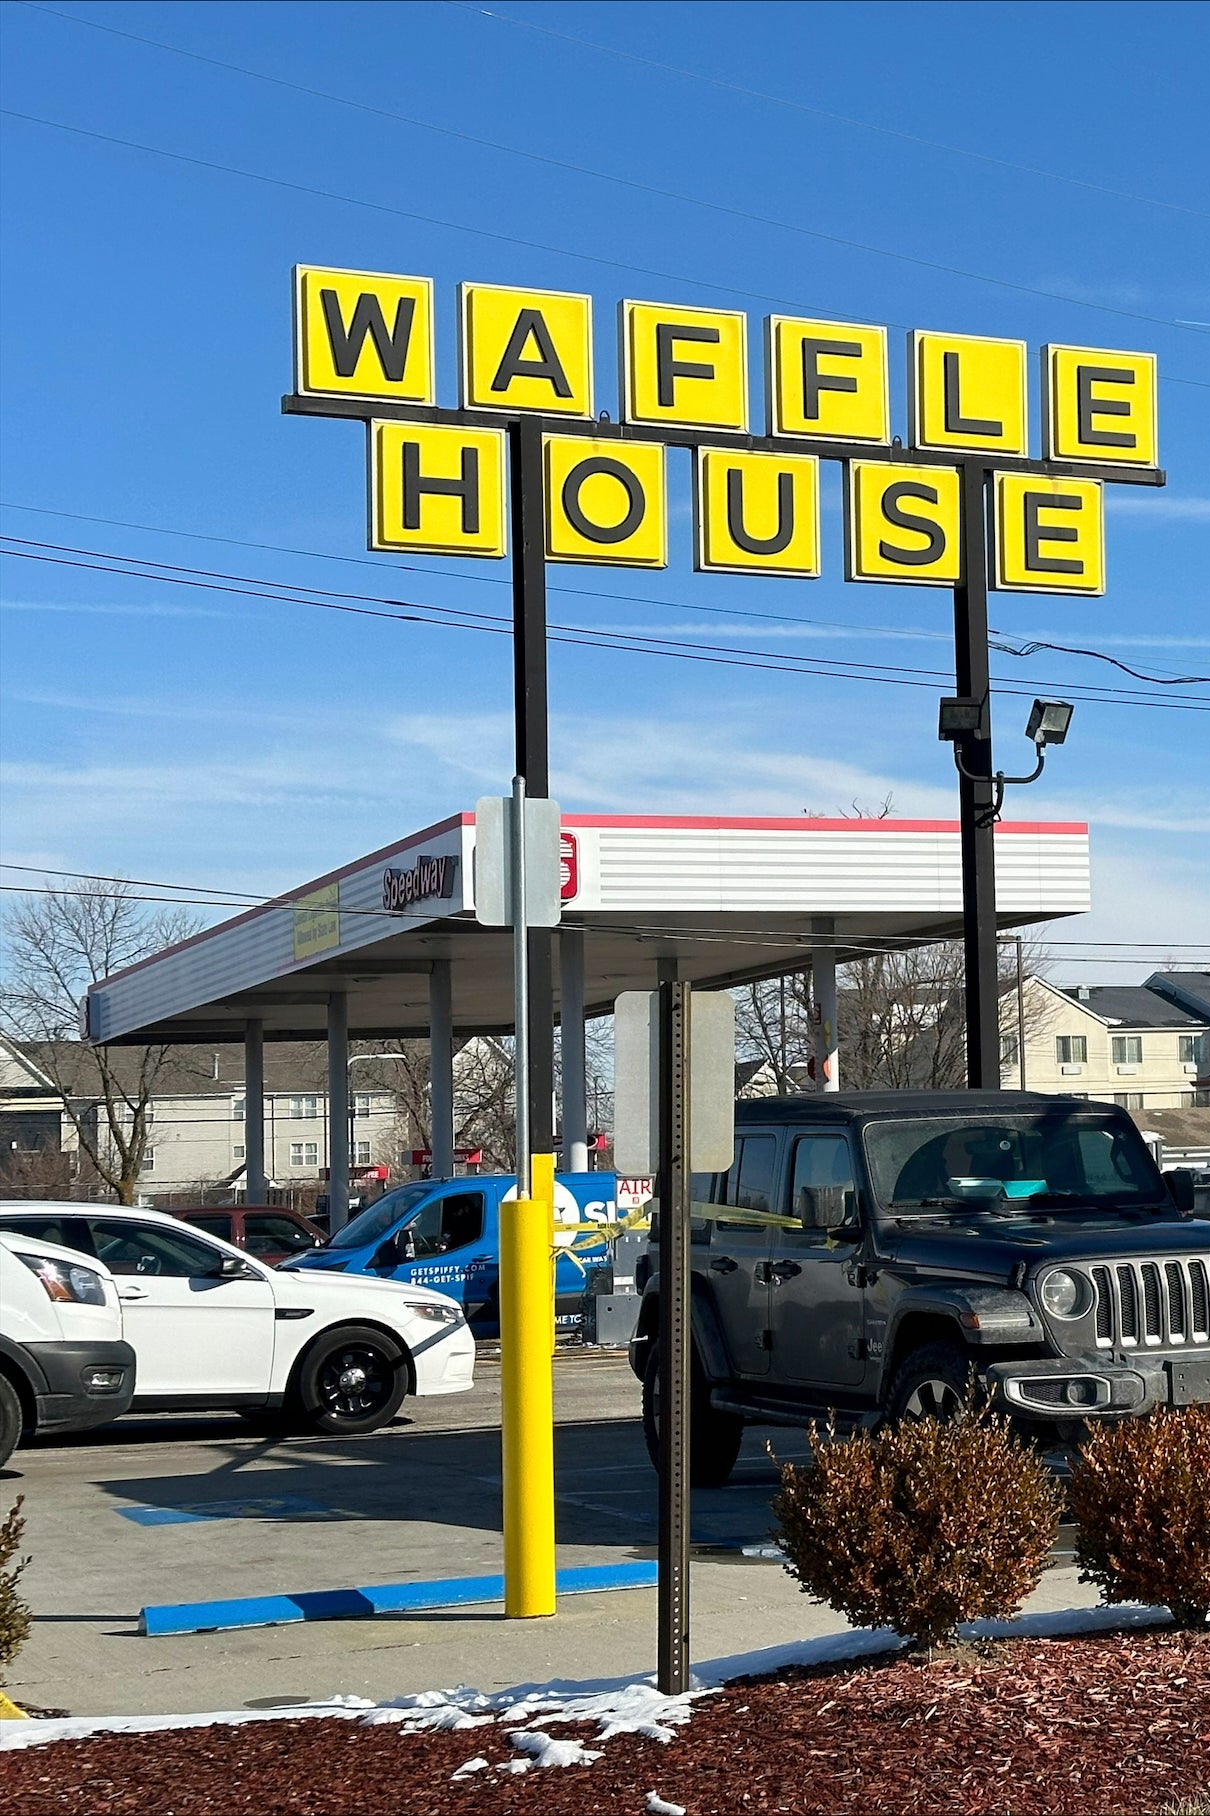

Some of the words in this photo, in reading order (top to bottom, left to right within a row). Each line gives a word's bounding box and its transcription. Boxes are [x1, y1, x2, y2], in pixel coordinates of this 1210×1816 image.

[319, 288, 1137, 449] WAFFLE
[401, 440, 1084, 575] HOUSE
[383, 855, 448, 910] Speedway
[619, 1179, 652, 1195] AIR
[410, 1263, 486, 1276] GETSPIFFY.COM
[866, 1338, 883, 1352] Jee
